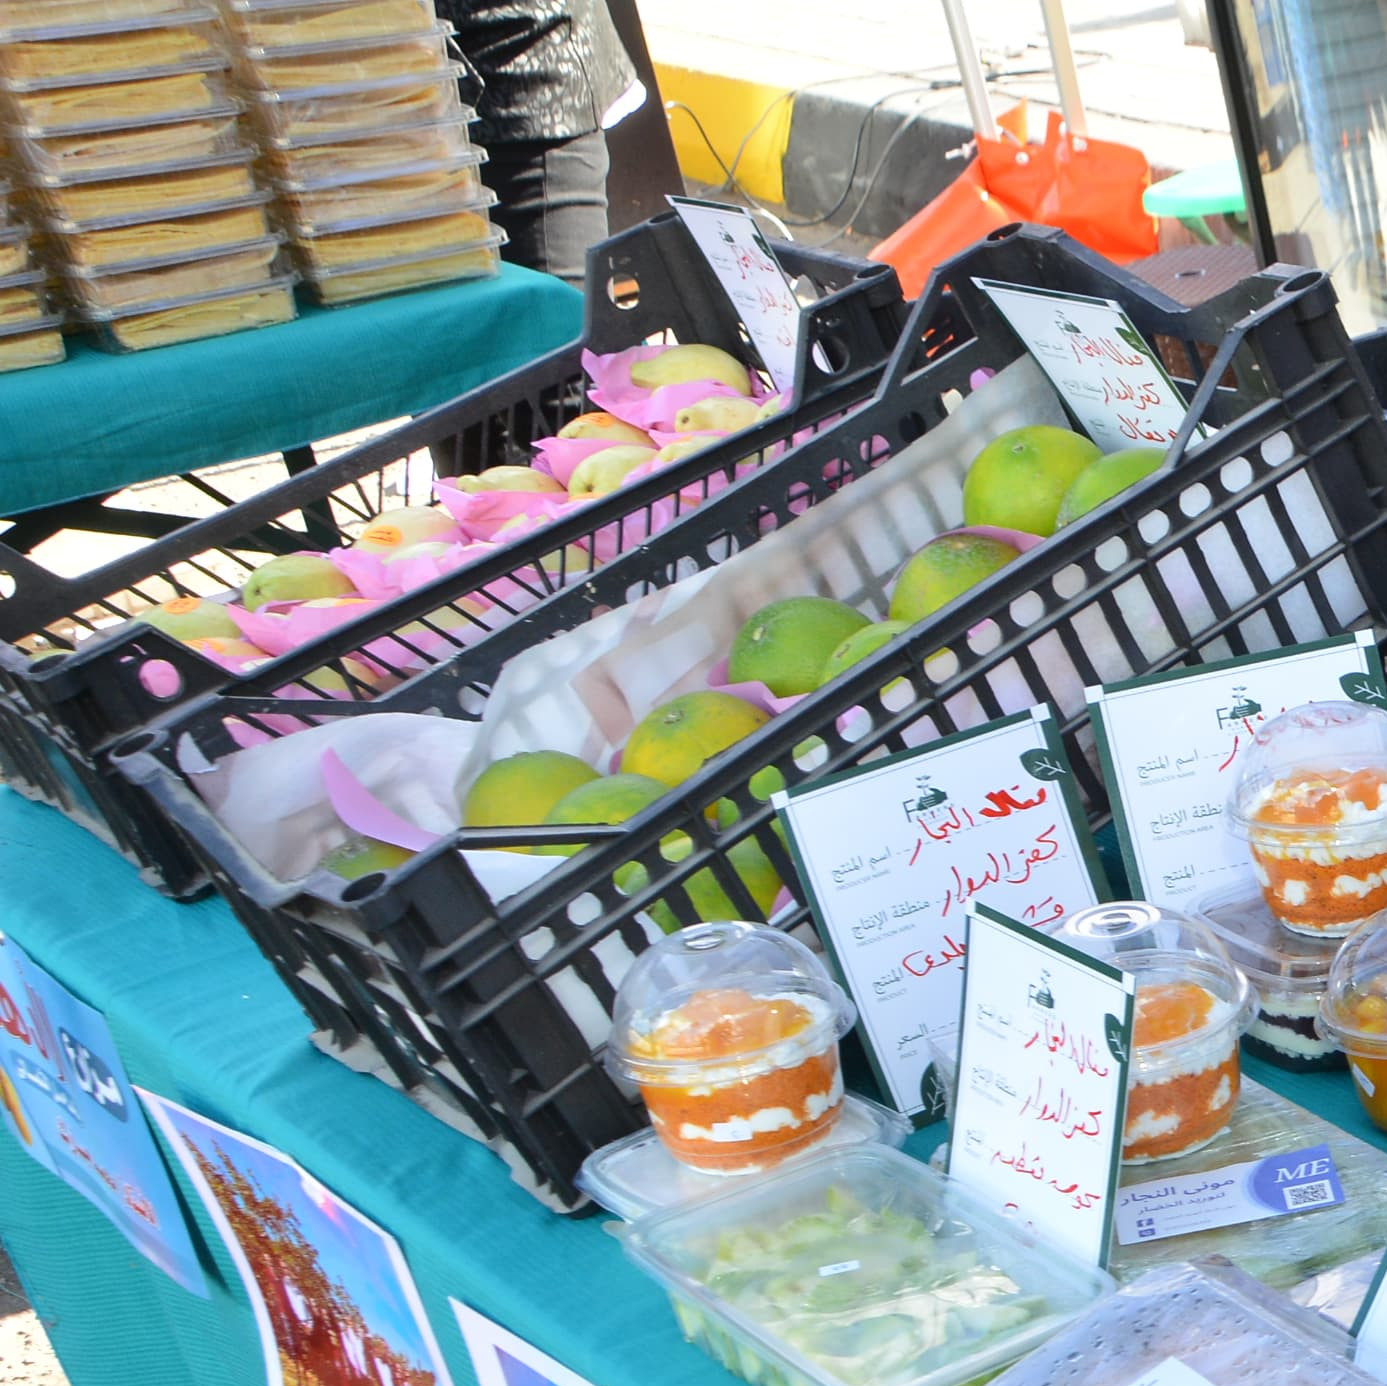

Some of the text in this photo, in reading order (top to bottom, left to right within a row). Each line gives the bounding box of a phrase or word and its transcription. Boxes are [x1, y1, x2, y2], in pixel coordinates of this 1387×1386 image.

[1191, 803, 1223, 819] نطقة
[1274, 1158, 1331, 1183] ME
[1119, 1186, 1177, 1208] النجار
